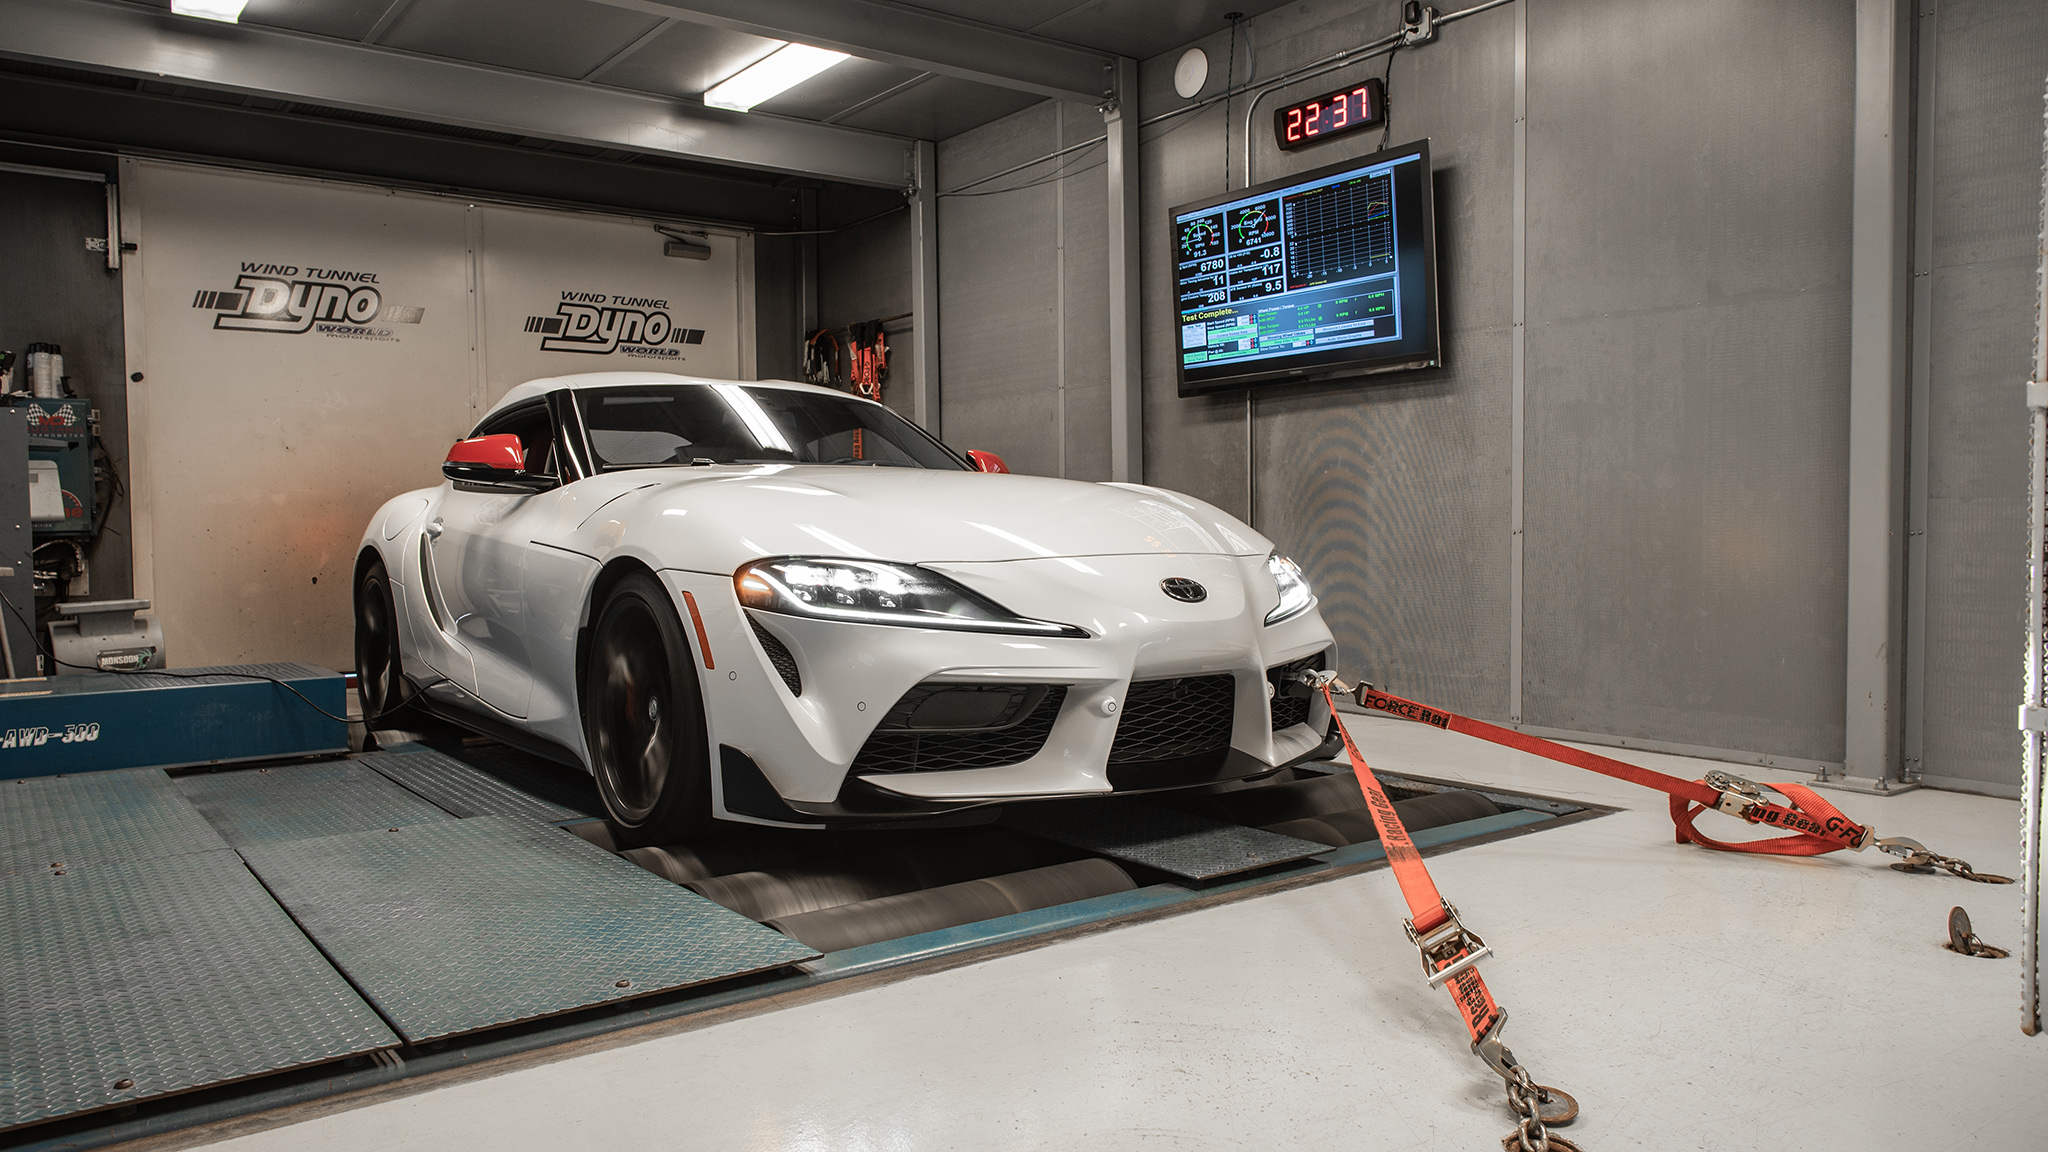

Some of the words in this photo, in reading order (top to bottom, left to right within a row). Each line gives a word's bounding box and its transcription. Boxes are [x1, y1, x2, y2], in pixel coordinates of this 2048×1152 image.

[1287, 88, 1367, 140] 22:37
[1246, 236, 1262, 246] 6741
[1260, 246, 1280, 259] -0.8
[1200, 259, 1224, 272] 6780
[1261, 263, 1281, 276] 117
[241, 262, 298, 276] WIND
[306, 268, 380, 284] TUNNEL
[1213, 274, 1224, 286] 11
[1265, 280, 1282, 292] 9.5
[561, 291, 606, 303] WIND
[612, 295, 670, 309] TUNNEL
[1208, 291, 1226, 303] 208
[213, 274, 383, 334] Dyno
[1181, 314, 1198, 322] Test
[316, 323, 394, 336] WORLD
[540, 302, 671, 354] Dyno
[326, 333, 400, 342] motorsports
[620, 345, 680, 356] WORLD
[39, 416, 65, 425] MD
[27, 426, 84, 434] USTANG
[101, 655, 139, 665] MONSOON
[1364, 694, 1419, 719] FORCE
[0, 722, 100, 748] AWD-500
[1367, 786, 1389, 809] Gear
[1752, 807, 1780, 823] ng
[1377, 808, 1407, 842] Racing
